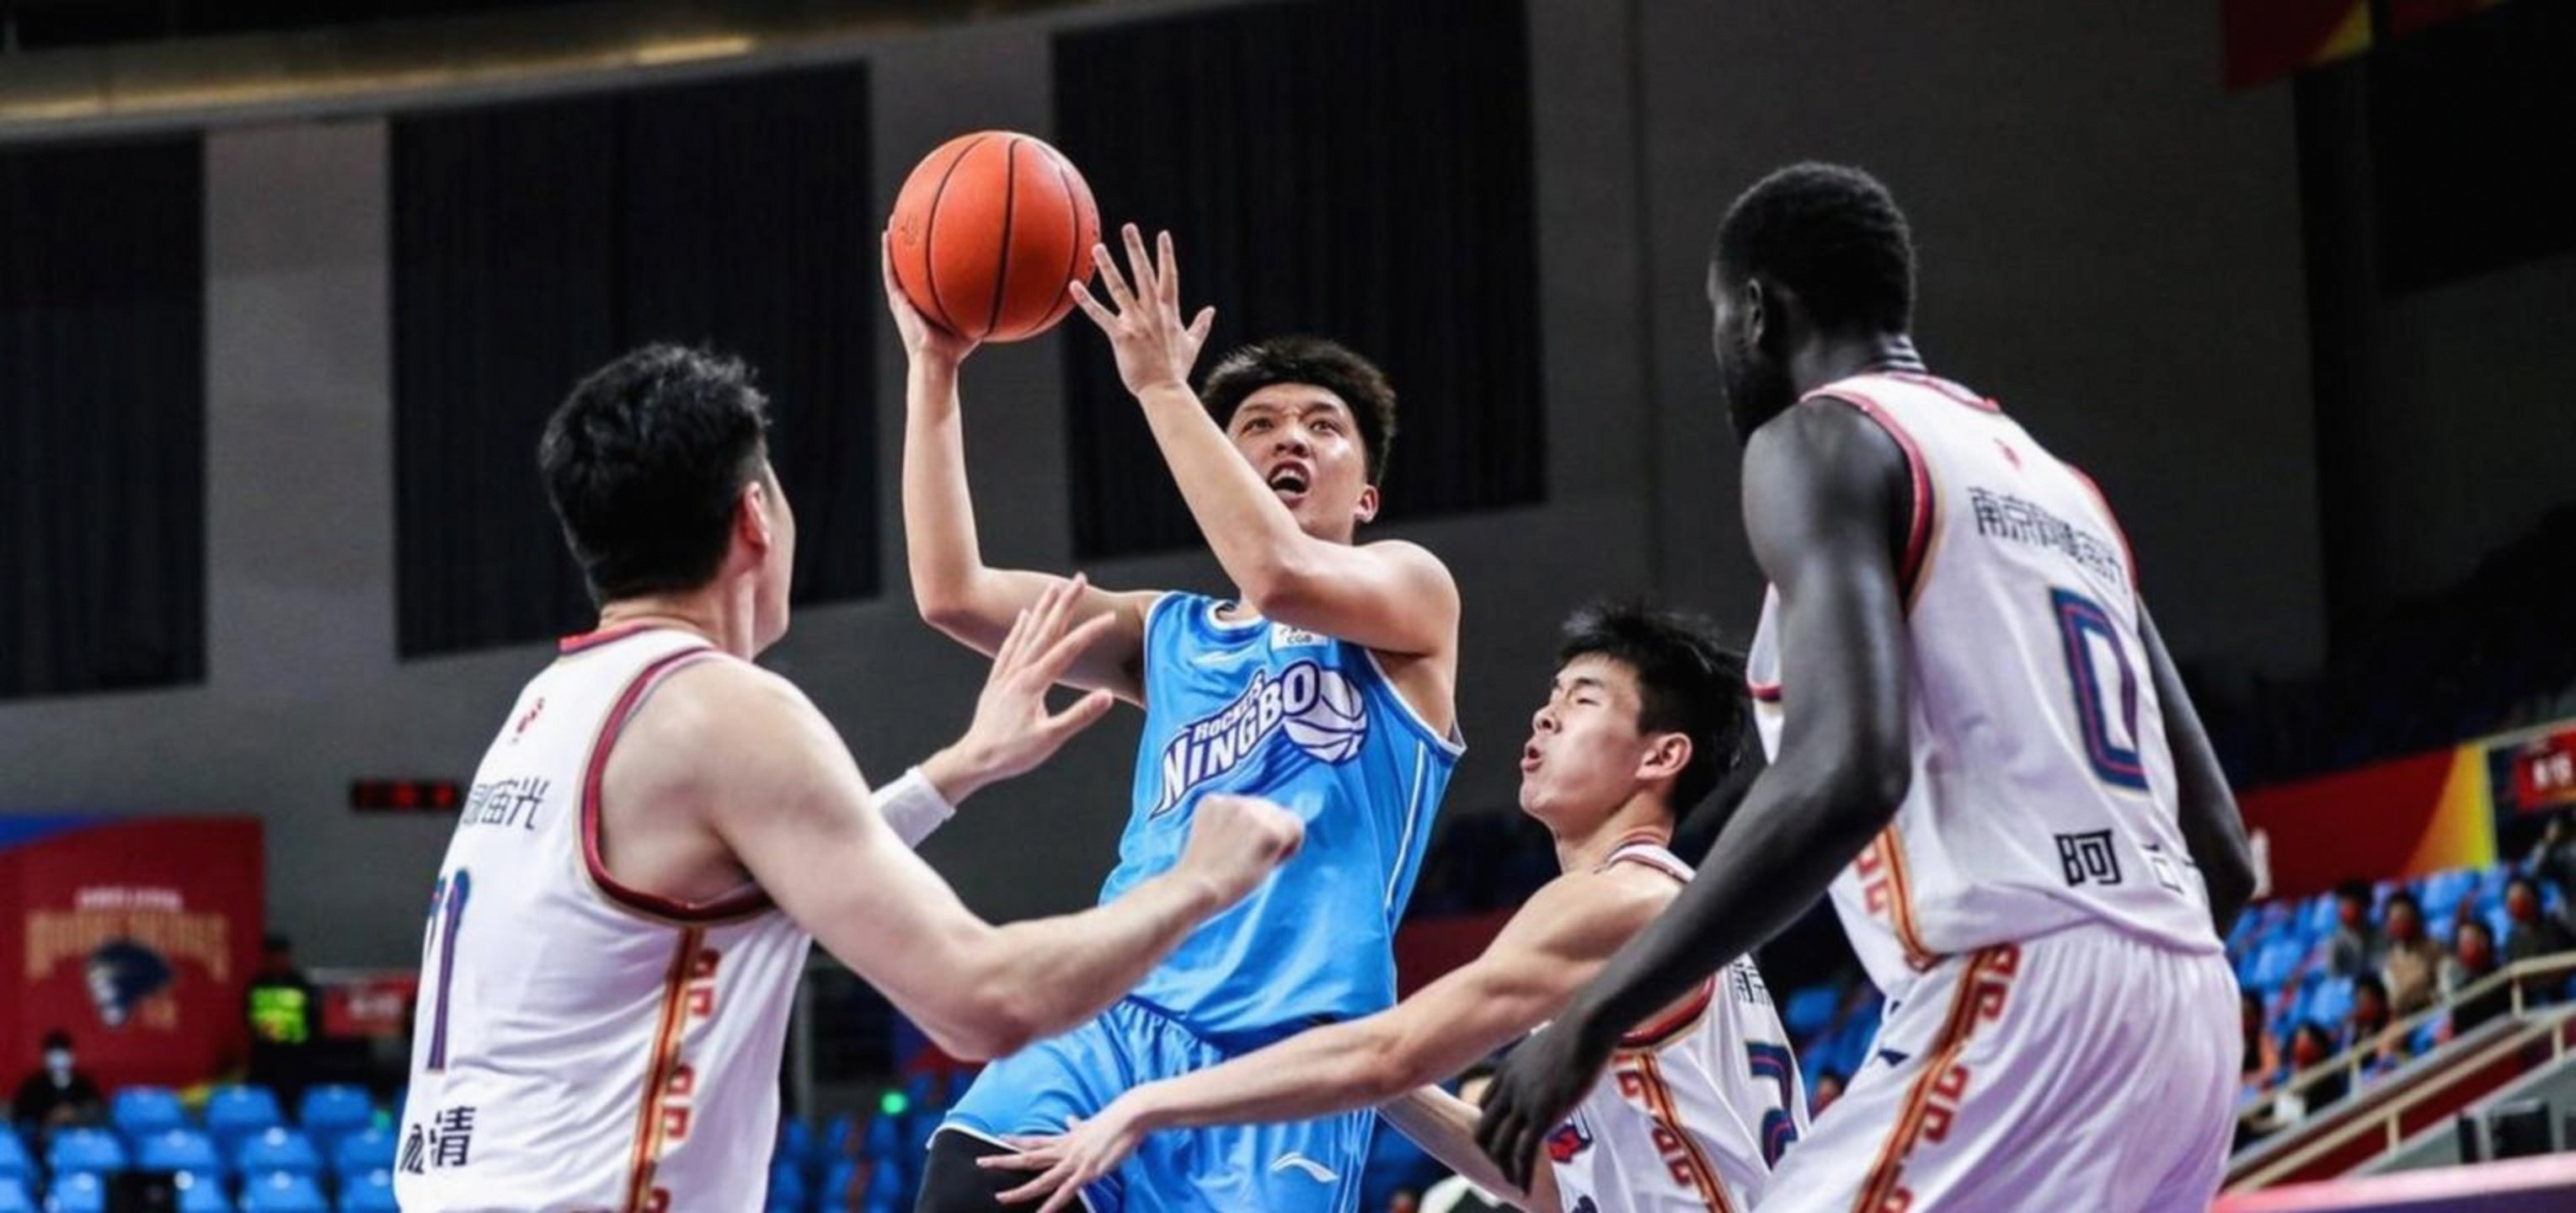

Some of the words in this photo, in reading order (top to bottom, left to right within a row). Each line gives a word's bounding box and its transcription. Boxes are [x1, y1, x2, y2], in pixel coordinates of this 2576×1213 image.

[1152, 660, 1322, 820] NINGBO
[1193, 671, 1264, 740] ROCKETS
[2050, 587, 2151, 791] 0
